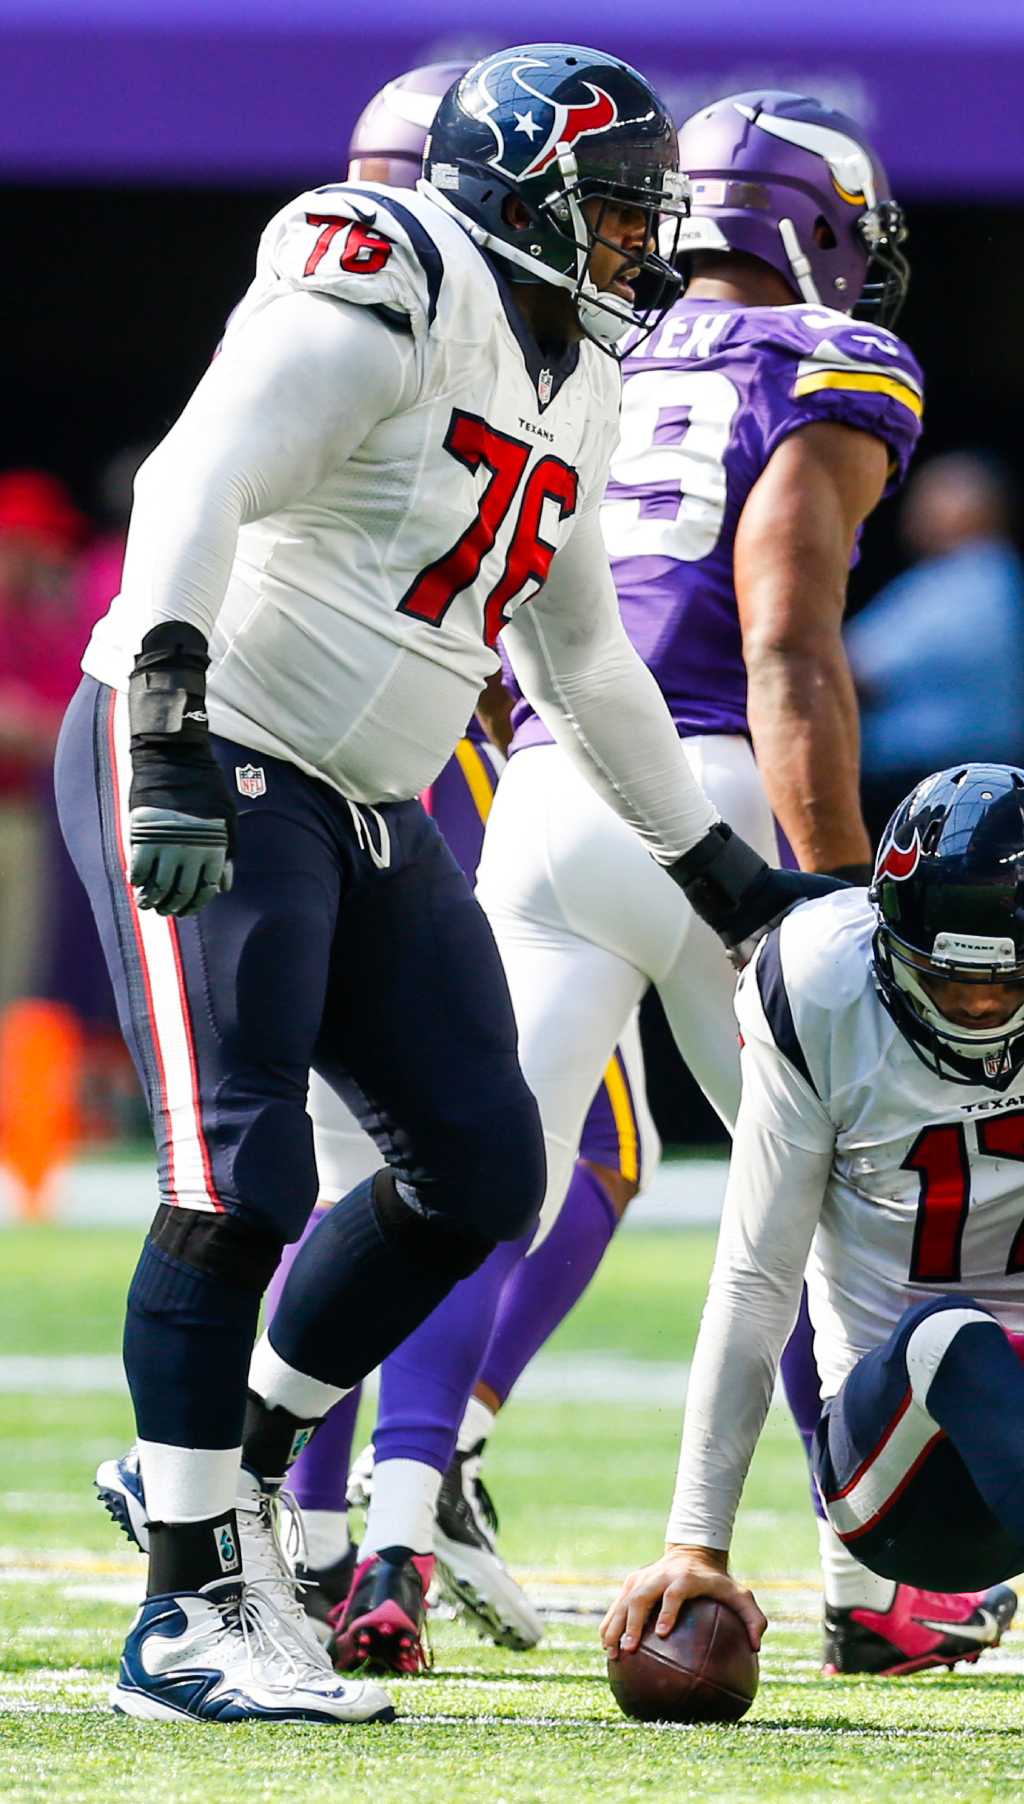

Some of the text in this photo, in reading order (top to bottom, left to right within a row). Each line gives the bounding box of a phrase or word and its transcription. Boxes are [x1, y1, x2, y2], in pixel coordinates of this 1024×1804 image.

[303, 211, 397, 277] 76
[518, 416, 555, 443] TEXANS
[396, 406, 579, 660] 76
